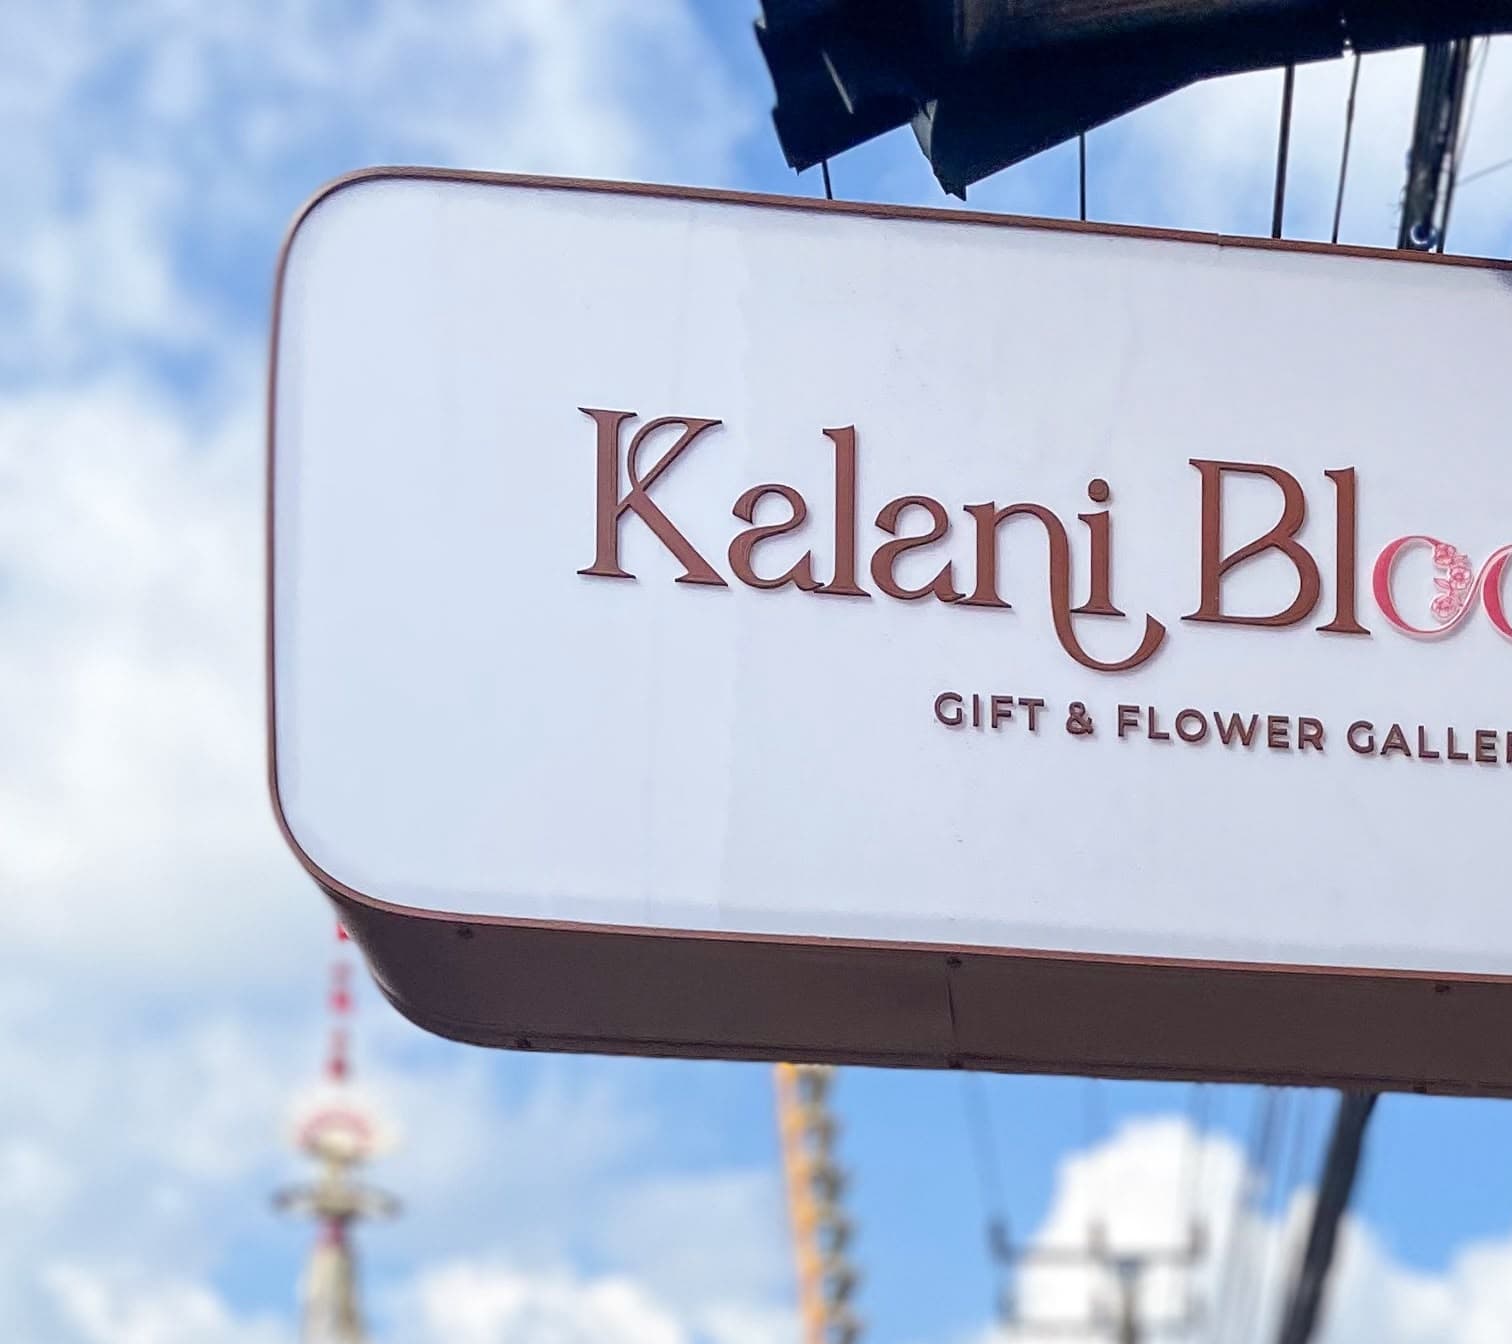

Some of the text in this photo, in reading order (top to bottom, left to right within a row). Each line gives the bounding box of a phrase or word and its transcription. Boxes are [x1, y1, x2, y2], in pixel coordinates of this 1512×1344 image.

[576, 406, 1167, 674] Kalani
[933, 691, 1046, 733] GIFT
[1065, 701, 1095, 737] &
[1116, 703, 1325, 752] FLOWER
